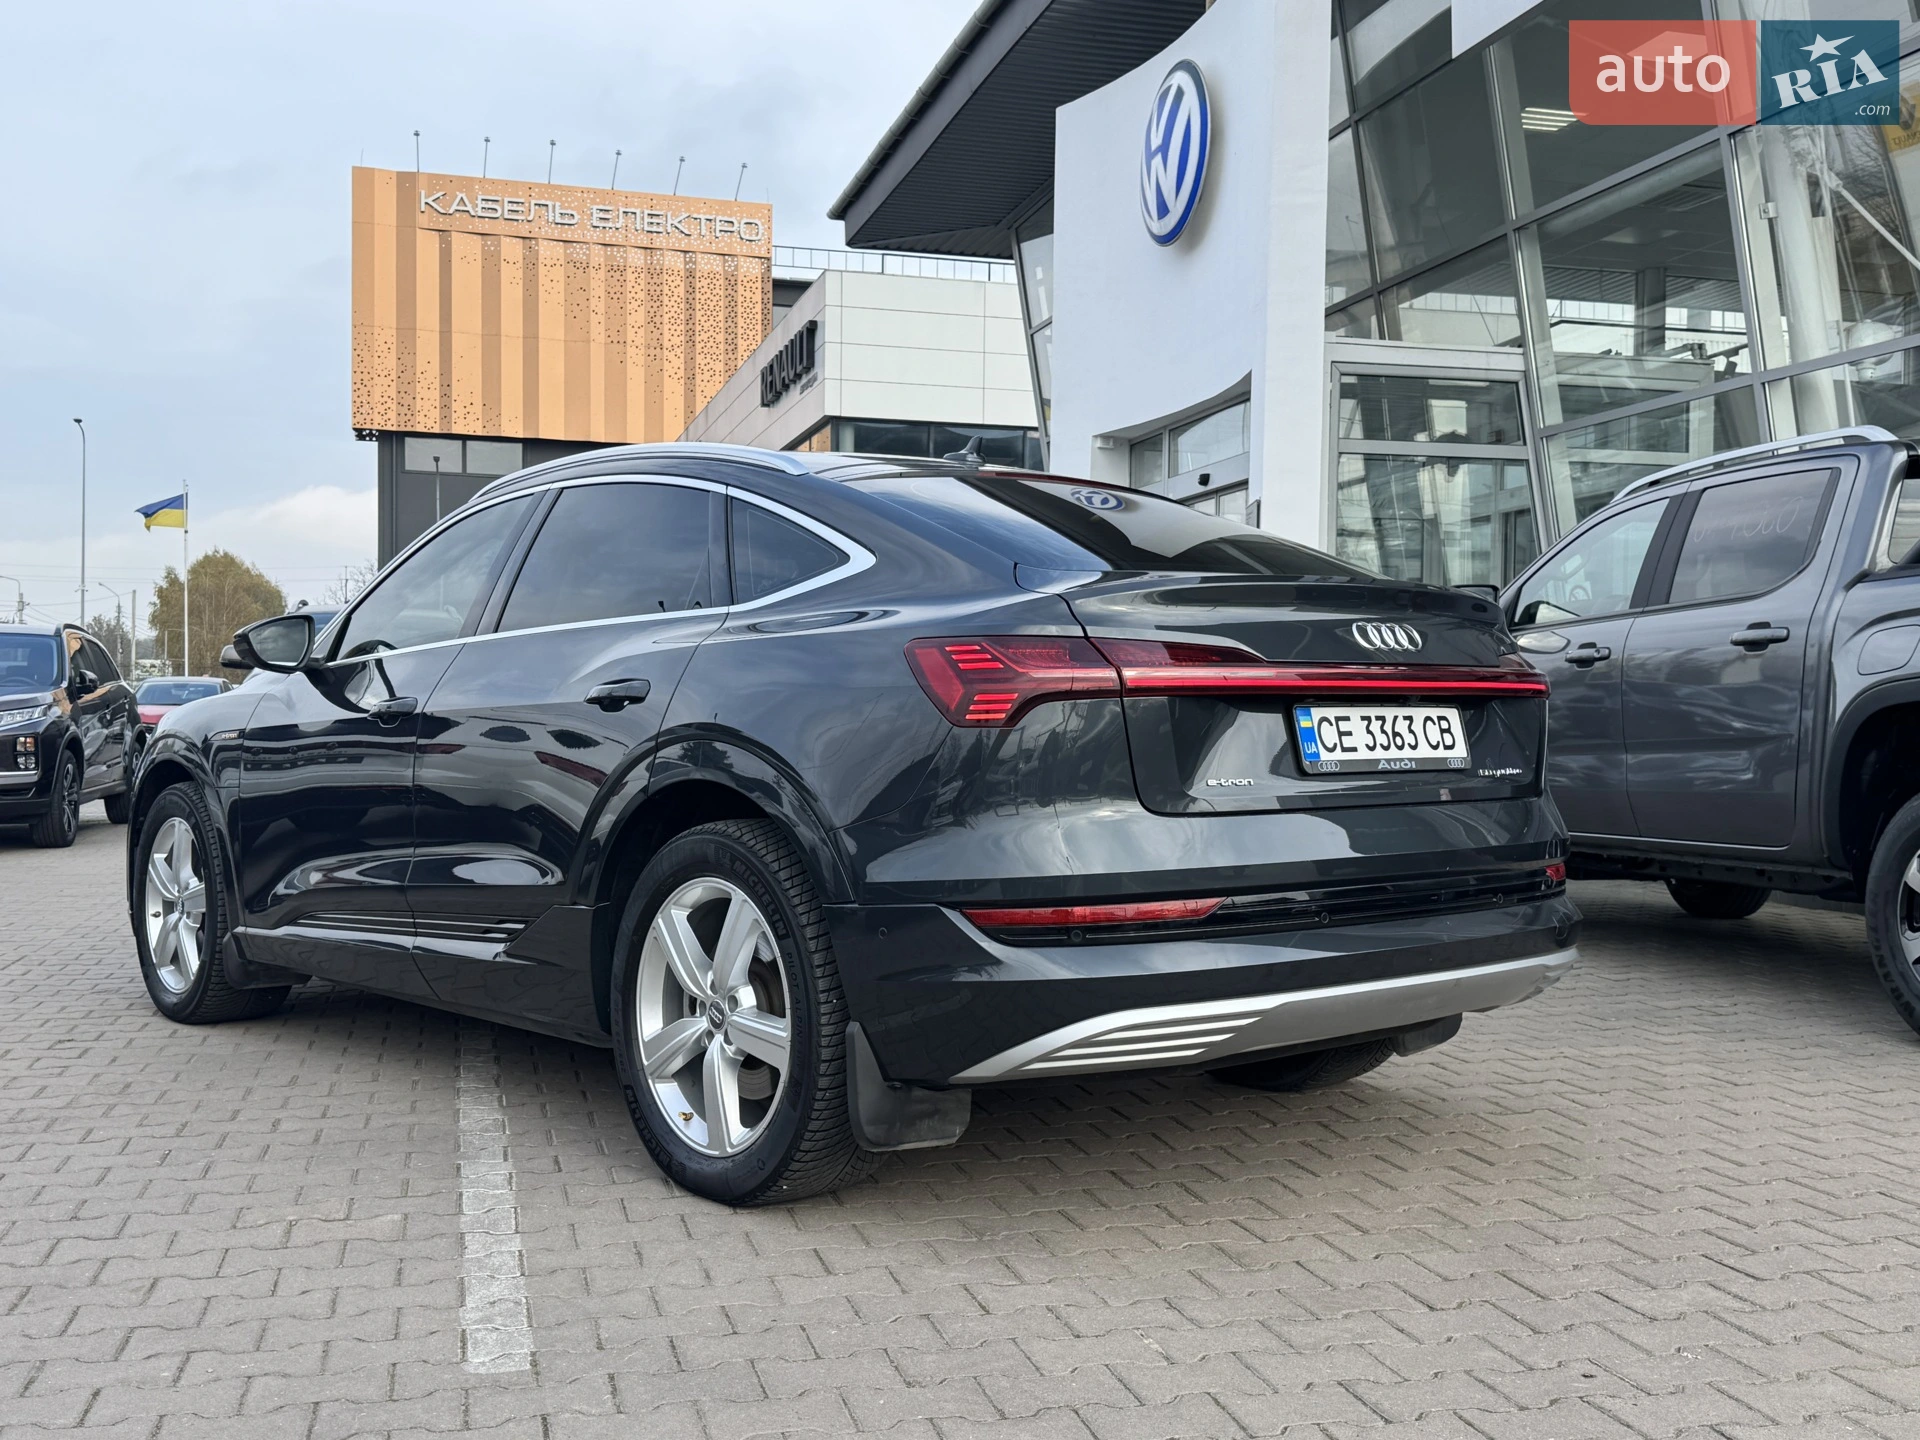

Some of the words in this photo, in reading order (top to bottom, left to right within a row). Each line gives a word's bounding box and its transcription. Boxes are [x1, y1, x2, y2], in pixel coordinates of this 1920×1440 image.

[418, 189, 580, 226] КАБЕЛЬ
[590, 204, 765, 242] ЕЛЕКТРО
[760, 319, 818, 408] RENAULT
[1304, 741, 1319, 754] UA
[1317, 715, 1358, 754] CE
[1360, 715, 1419, 752] 3363
[1422, 715, 1456, 751] CB
[1206, 777, 1255, 787] e-tron
[1377, 759, 1416, 770] Audi
[731, 859, 790, 938] MICHELIN
[785, 952, 800, 990] PILOT
